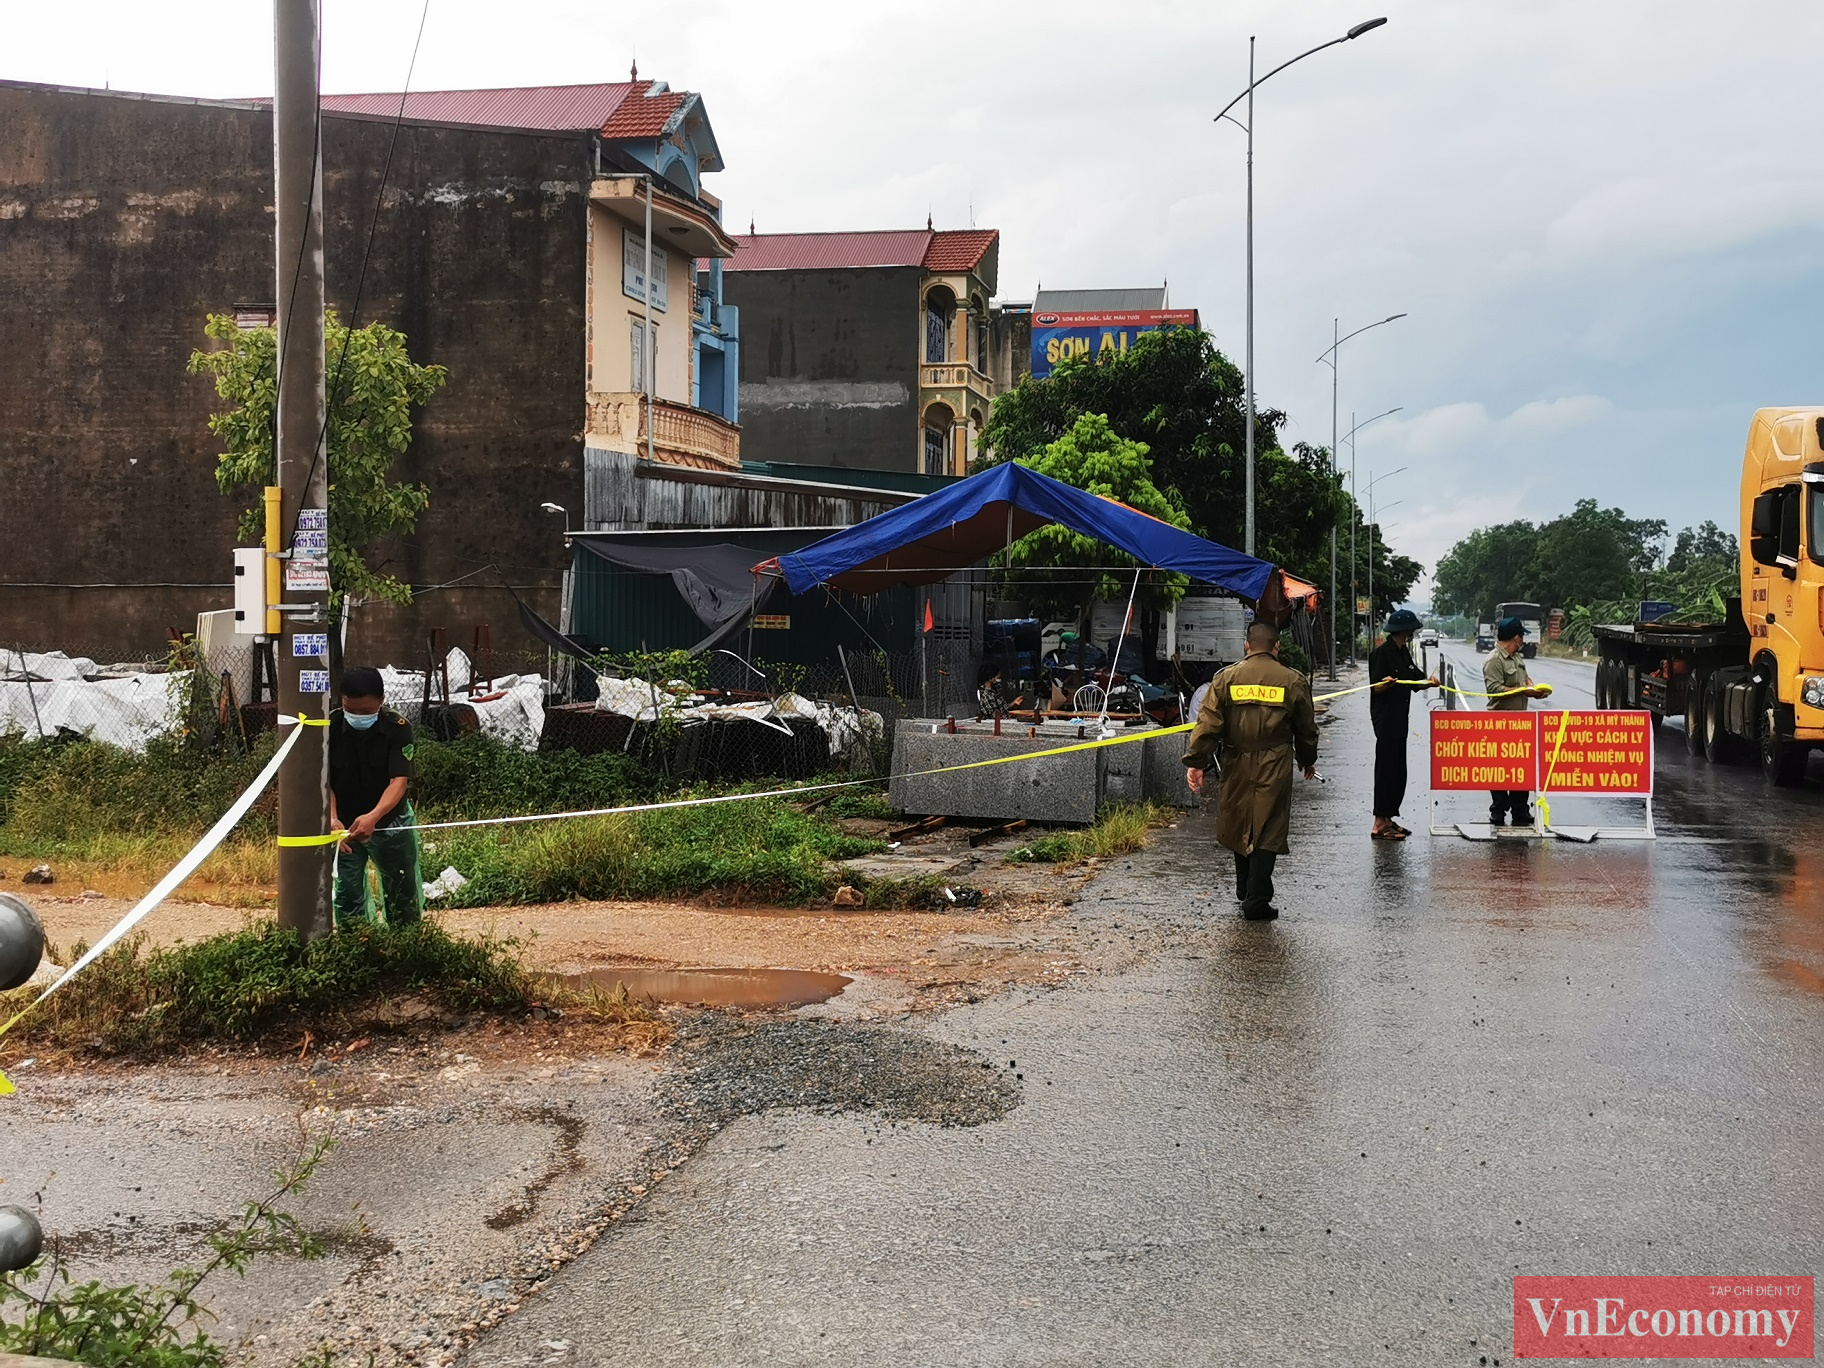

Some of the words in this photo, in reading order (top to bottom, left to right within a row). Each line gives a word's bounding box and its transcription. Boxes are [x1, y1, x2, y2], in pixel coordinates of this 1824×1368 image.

[1047, 337, 1090, 365] SƠN
[1235, 687, 1277, 699] C.A.N.D
[1434, 719, 1449, 730] BCĐ
[1450, 719, 1483, 730] COVID-19
[1495, 718, 1507, 730] MỸ
[1508, 718, 1532, 730] THÀNH
[1543, 715, 1559, 726] BCĐ
[1606, 714, 1618, 726] MỸ
[1620, 714, 1645, 726] THÀNH
[1435, 736, 1465, 758] CHỐT
[1468, 735, 1498, 758] KIỂM
[1501, 739, 1532, 758] SOÁT
[1571, 730, 1593, 746] VỰC
[1596, 729, 1628, 744] CÁCH
[1631, 731, 1644, 744] LY
[1587, 748, 1625, 765] NHIỆM
[1629, 751, 1644, 766] VỤ
[1441, 766, 1468, 786] DỊCH
[1472, 766, 1525, 783] COVID-19
[1551, 768, 1594, 787] MIỄN
[1599, 770, 1638, 787] VÀO!
